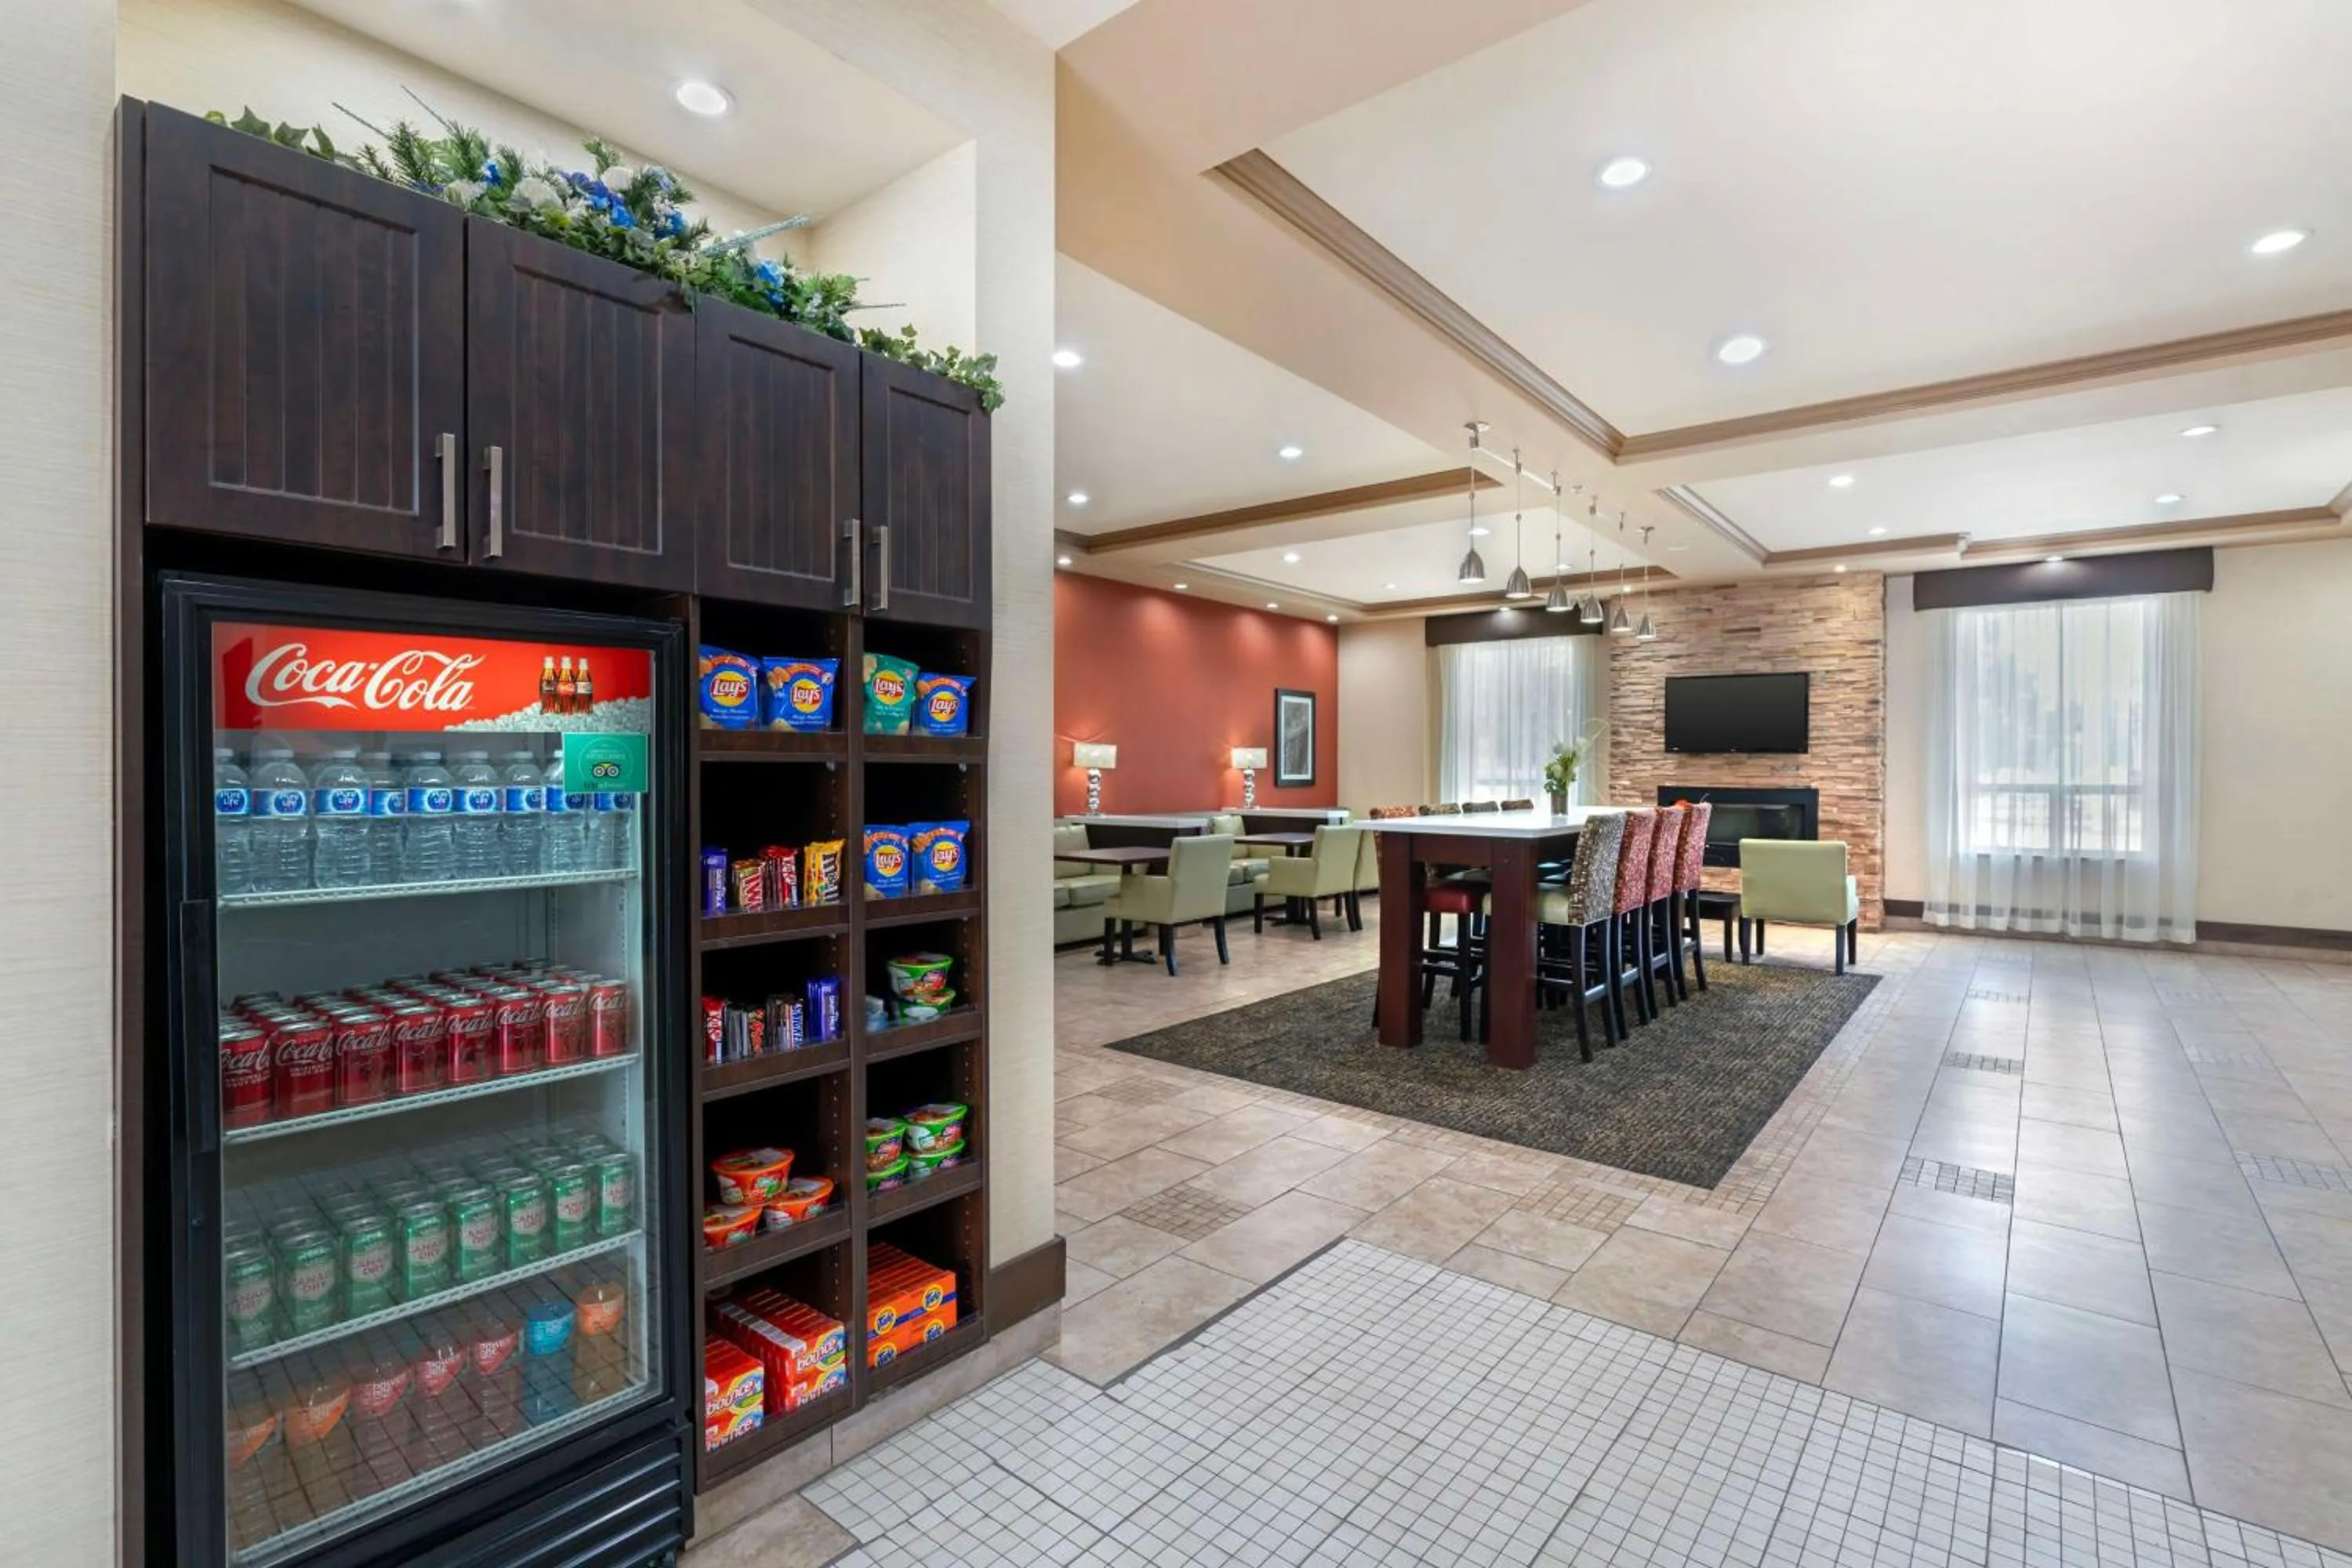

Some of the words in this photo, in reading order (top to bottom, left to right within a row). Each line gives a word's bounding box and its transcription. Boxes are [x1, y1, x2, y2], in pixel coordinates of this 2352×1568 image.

[245, 643, 487, 710] Coca-Cola
[714, 678, 747, 697] Lay's
[793, 686, 822, 704] Lay's
[874, 677, 904, 696] Lay's
[931, 699, 956, 715] Lay's
[797, 1338, 838, 1374] bounce
[705, 1380, 756, 1417] bounce
